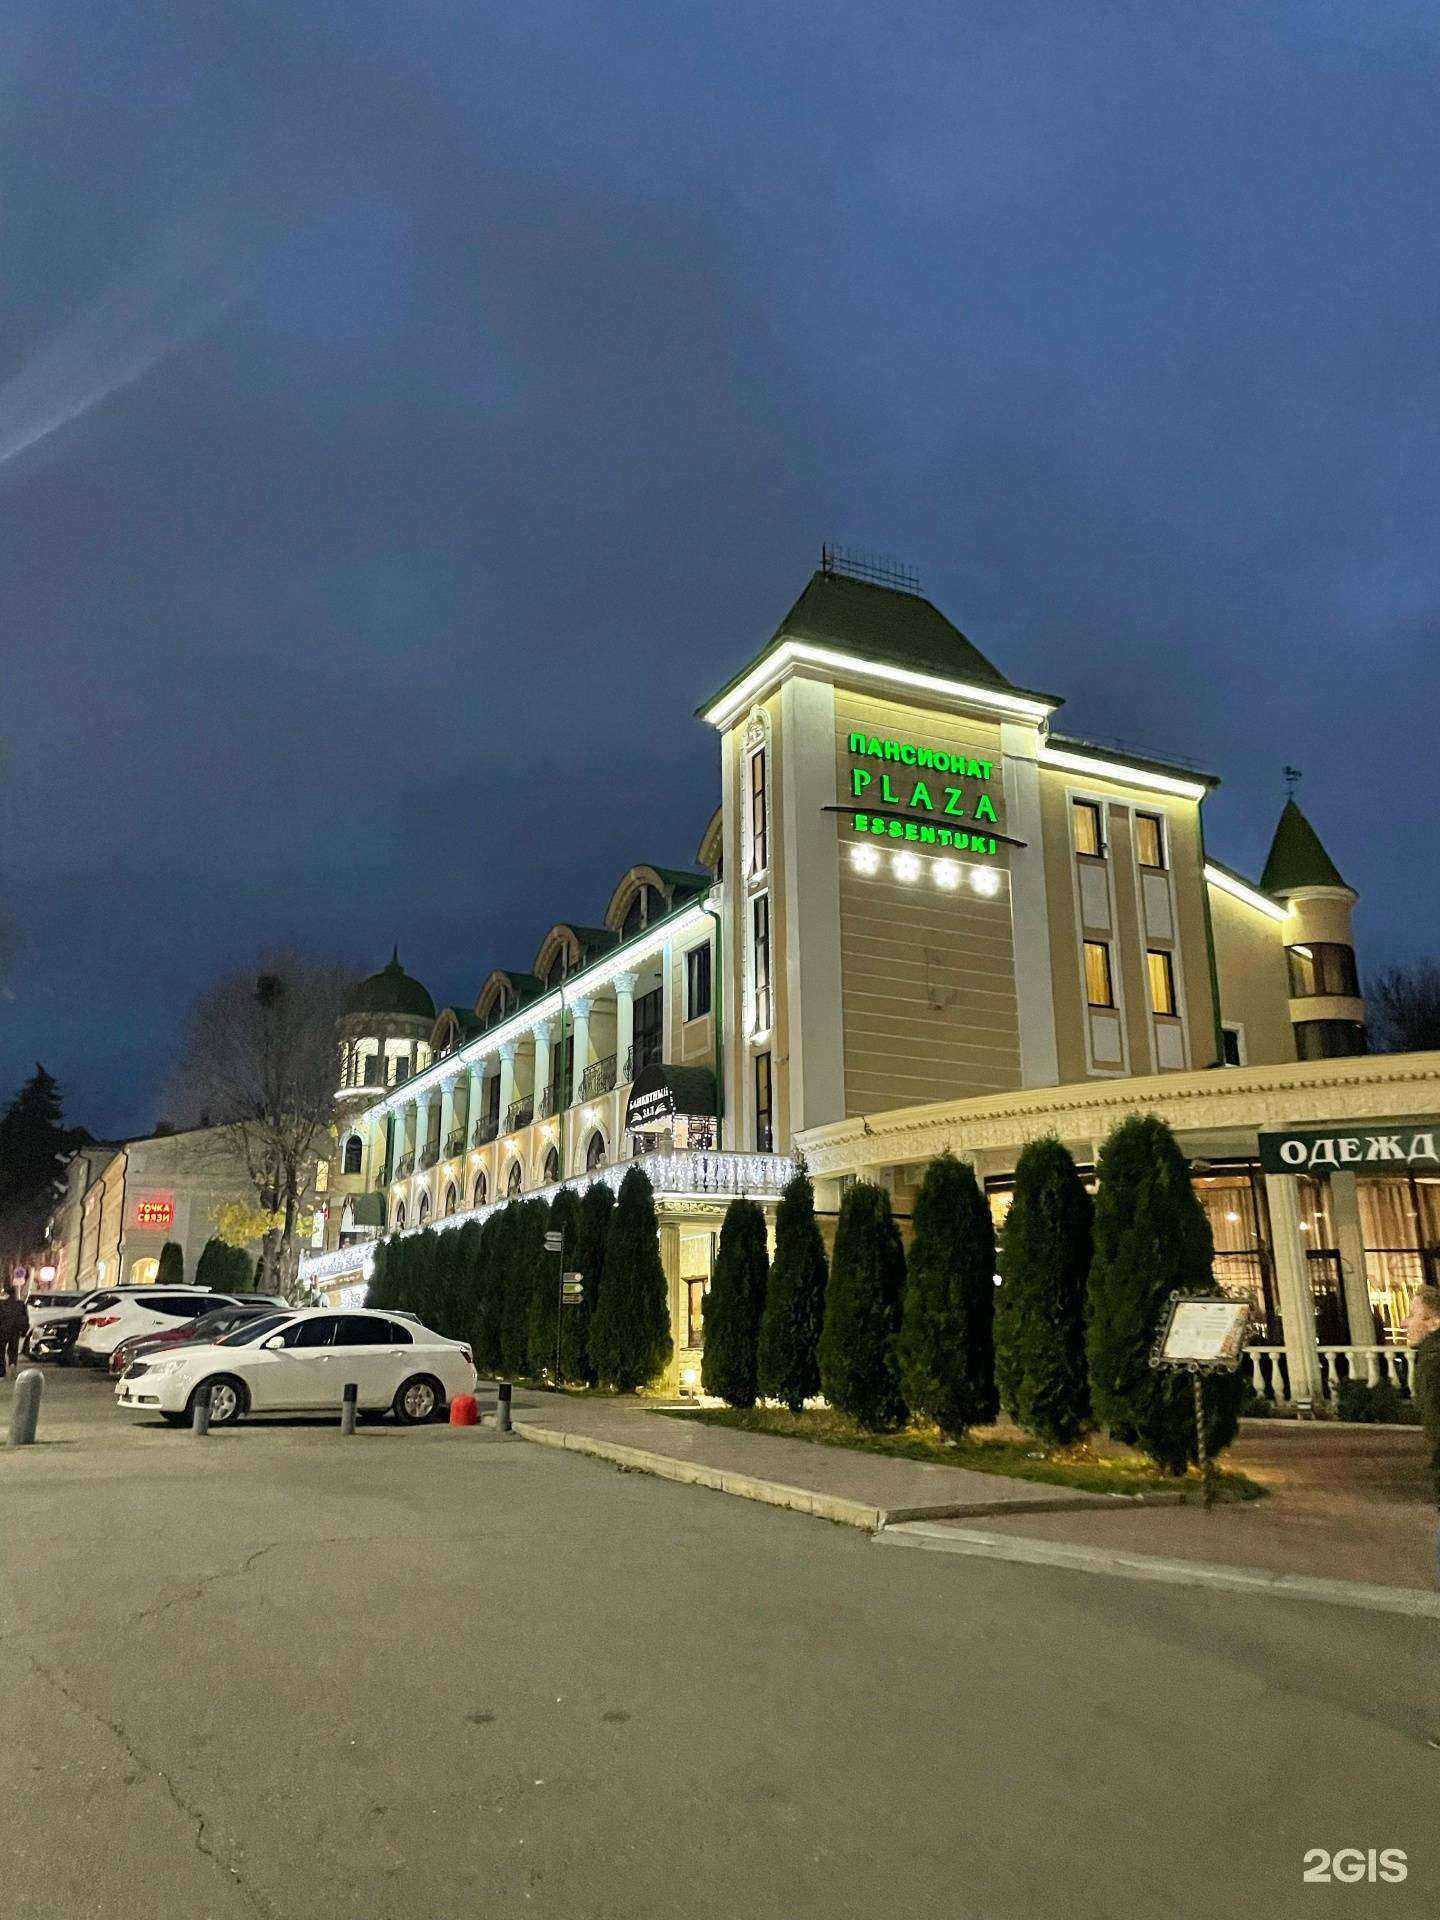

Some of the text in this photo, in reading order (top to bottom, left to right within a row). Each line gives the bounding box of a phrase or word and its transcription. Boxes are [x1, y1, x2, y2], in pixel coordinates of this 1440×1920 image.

[848, 732, 993, 781] ПАНСИОНАТ
[852, 768, 998, 823] PLAZA
[854, 813, 997, 856] ESSENTUKI
[137, 1213, 170, 1223] СВЯЗИ
[138, 1203, 170, 1213] ТОЧКА
